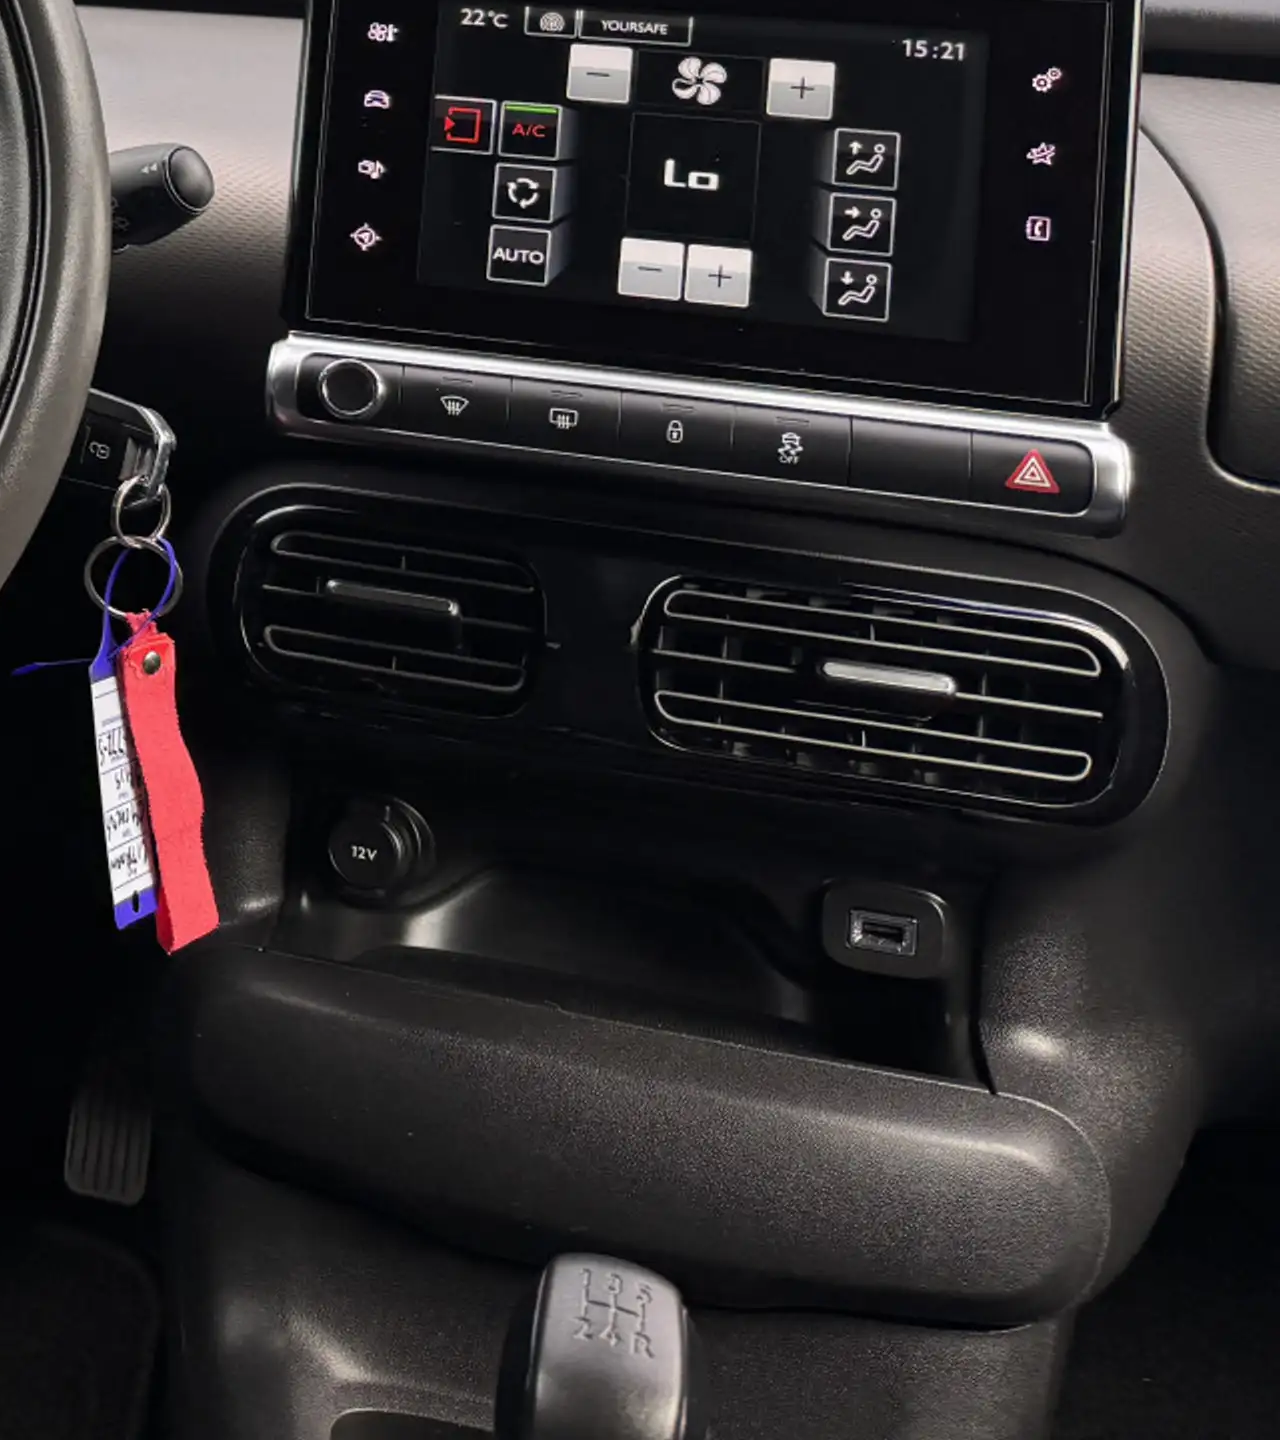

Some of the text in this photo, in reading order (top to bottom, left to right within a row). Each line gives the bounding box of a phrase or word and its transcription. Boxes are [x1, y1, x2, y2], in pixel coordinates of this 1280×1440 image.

[460, 7, 509, 28] 22°C
[600, 19, 669, 35] YOURSAFE
[902, 38, 966, 62] 15:21
[512, 123, 546, 138] A/C
[663, 158, 719, 191] Lo
[492, 246, 545, 264] AUTO
[779, 455, 799, 464] OFF
[351, 845, 378, 861] 12V
